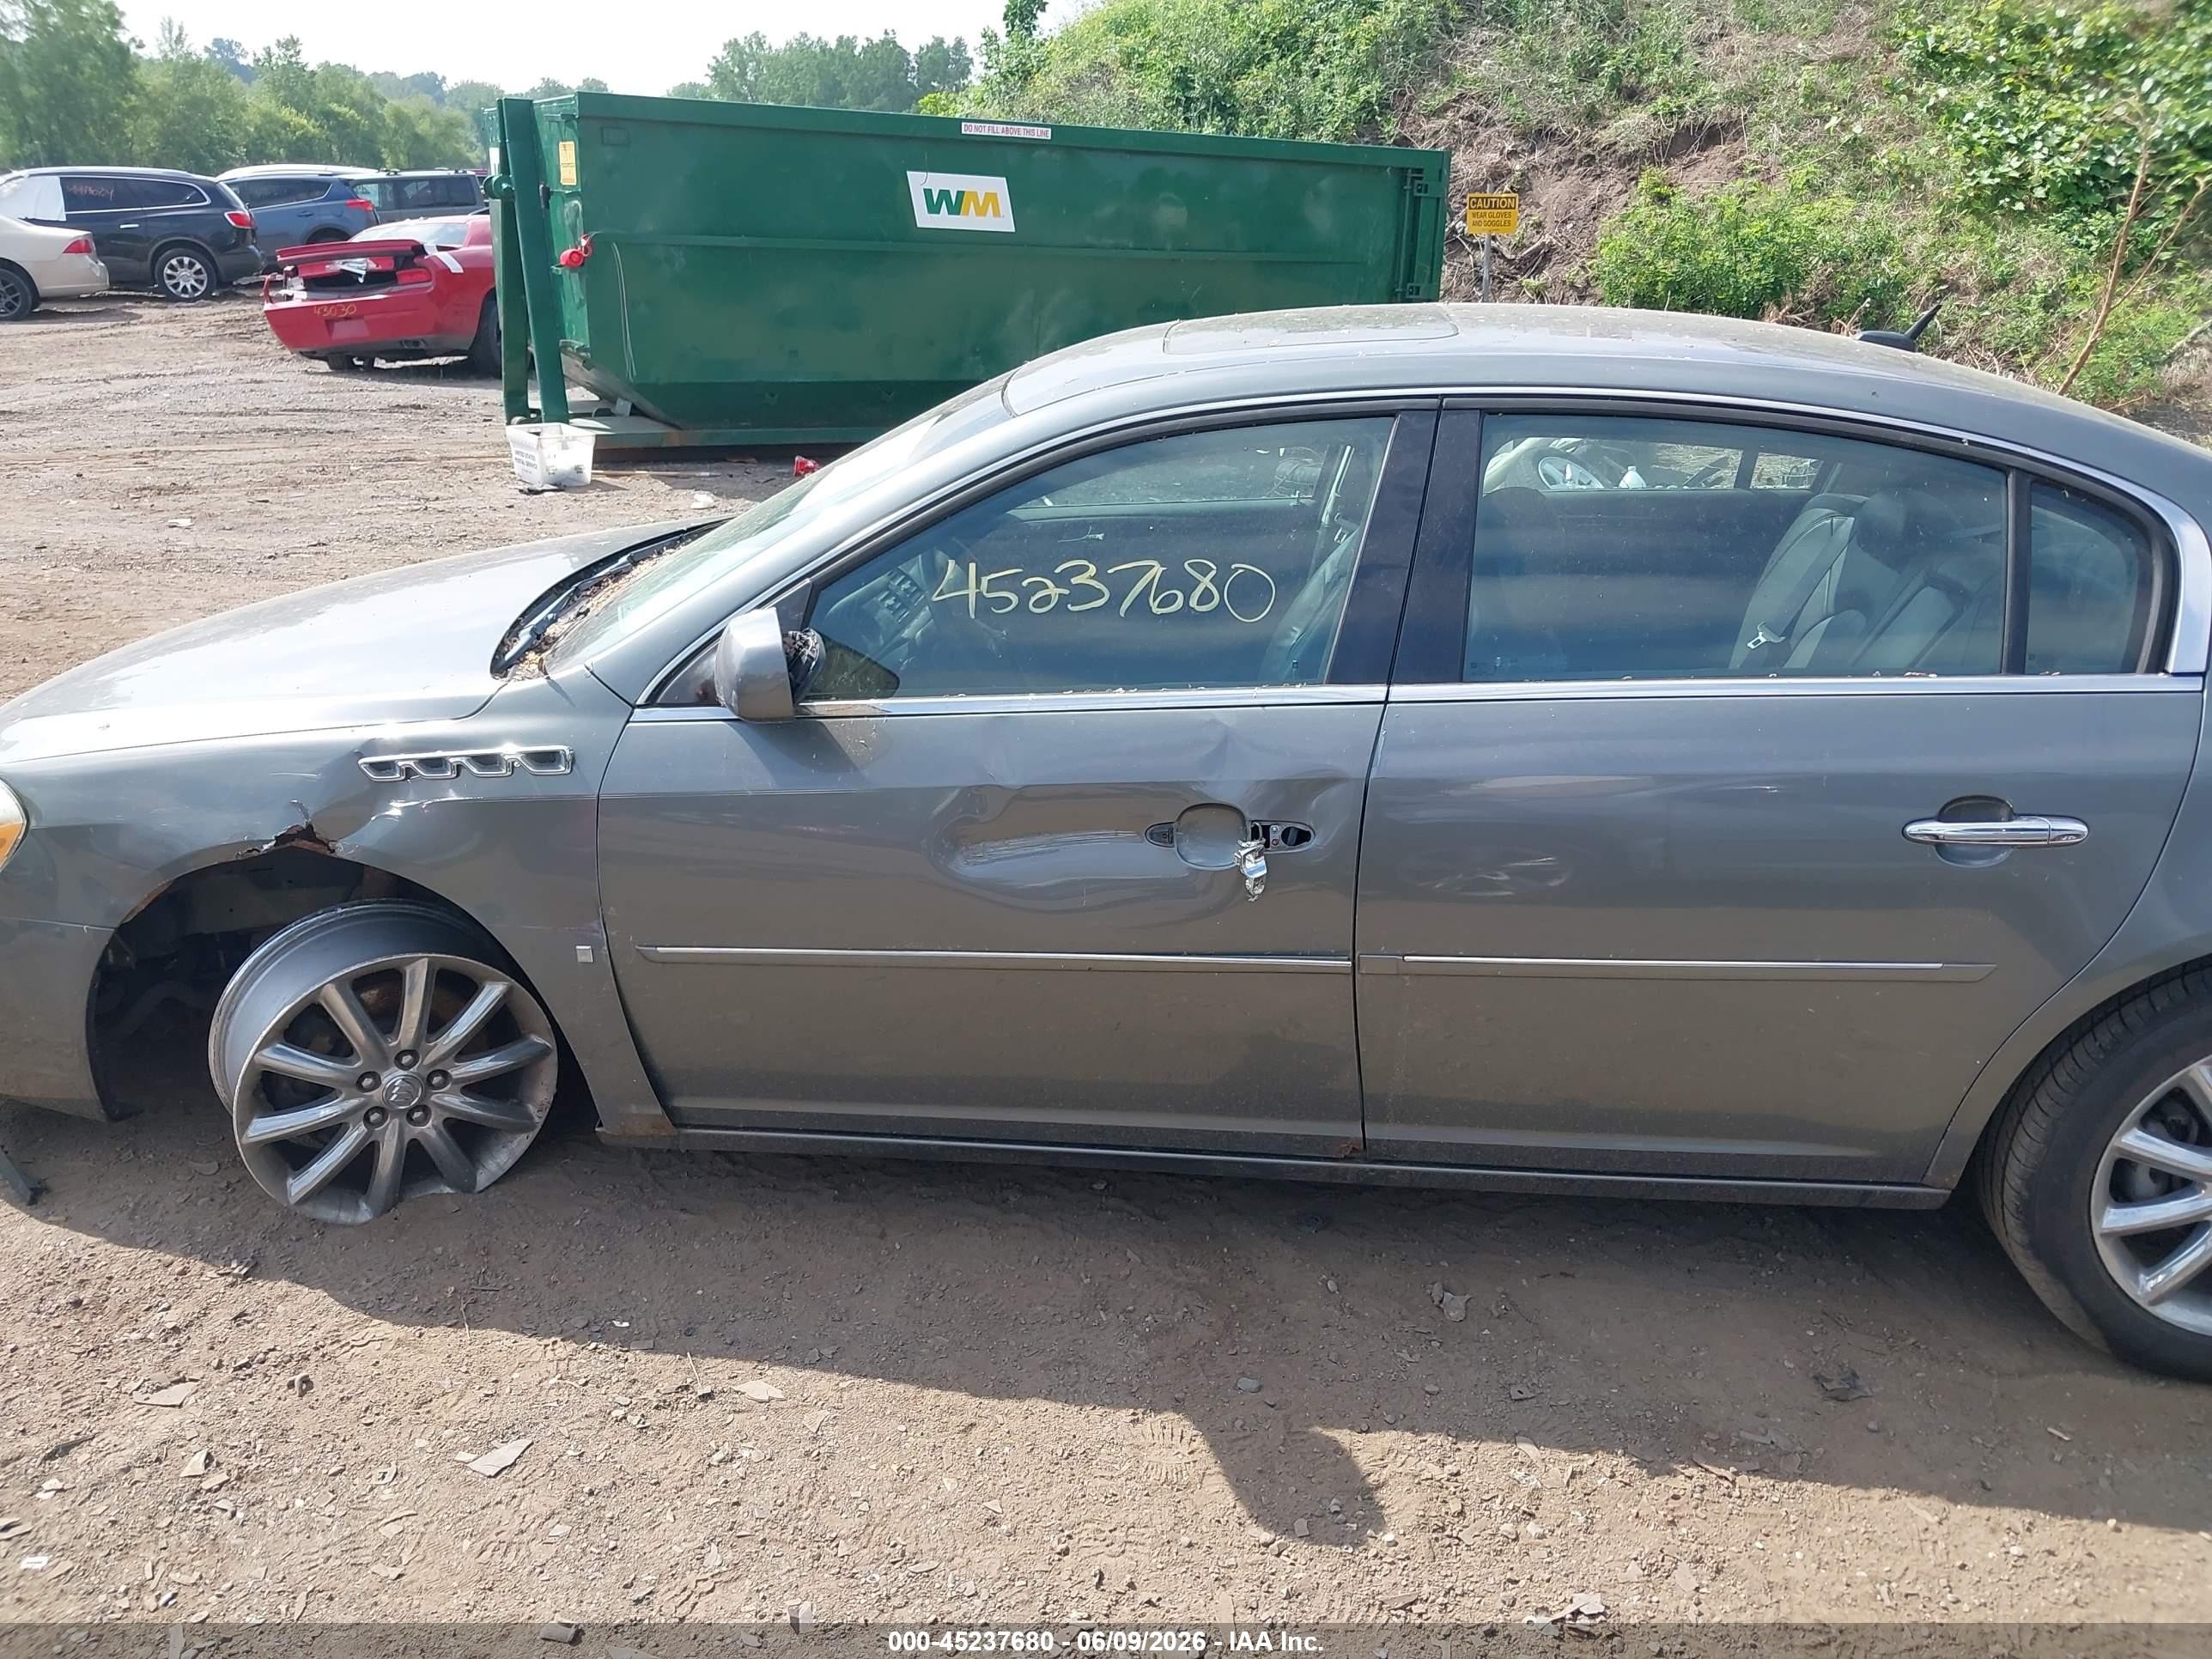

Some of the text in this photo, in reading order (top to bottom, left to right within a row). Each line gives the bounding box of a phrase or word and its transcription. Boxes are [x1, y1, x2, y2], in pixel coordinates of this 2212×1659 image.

[963, 124, 1049, 137] DO NOT FILL ABOVE THIS LINE
[923, 188, 1001, 218] WM
[1469, 198, 1516, 209] CAUTION
[931, 558, 1277, 623] 45237680
